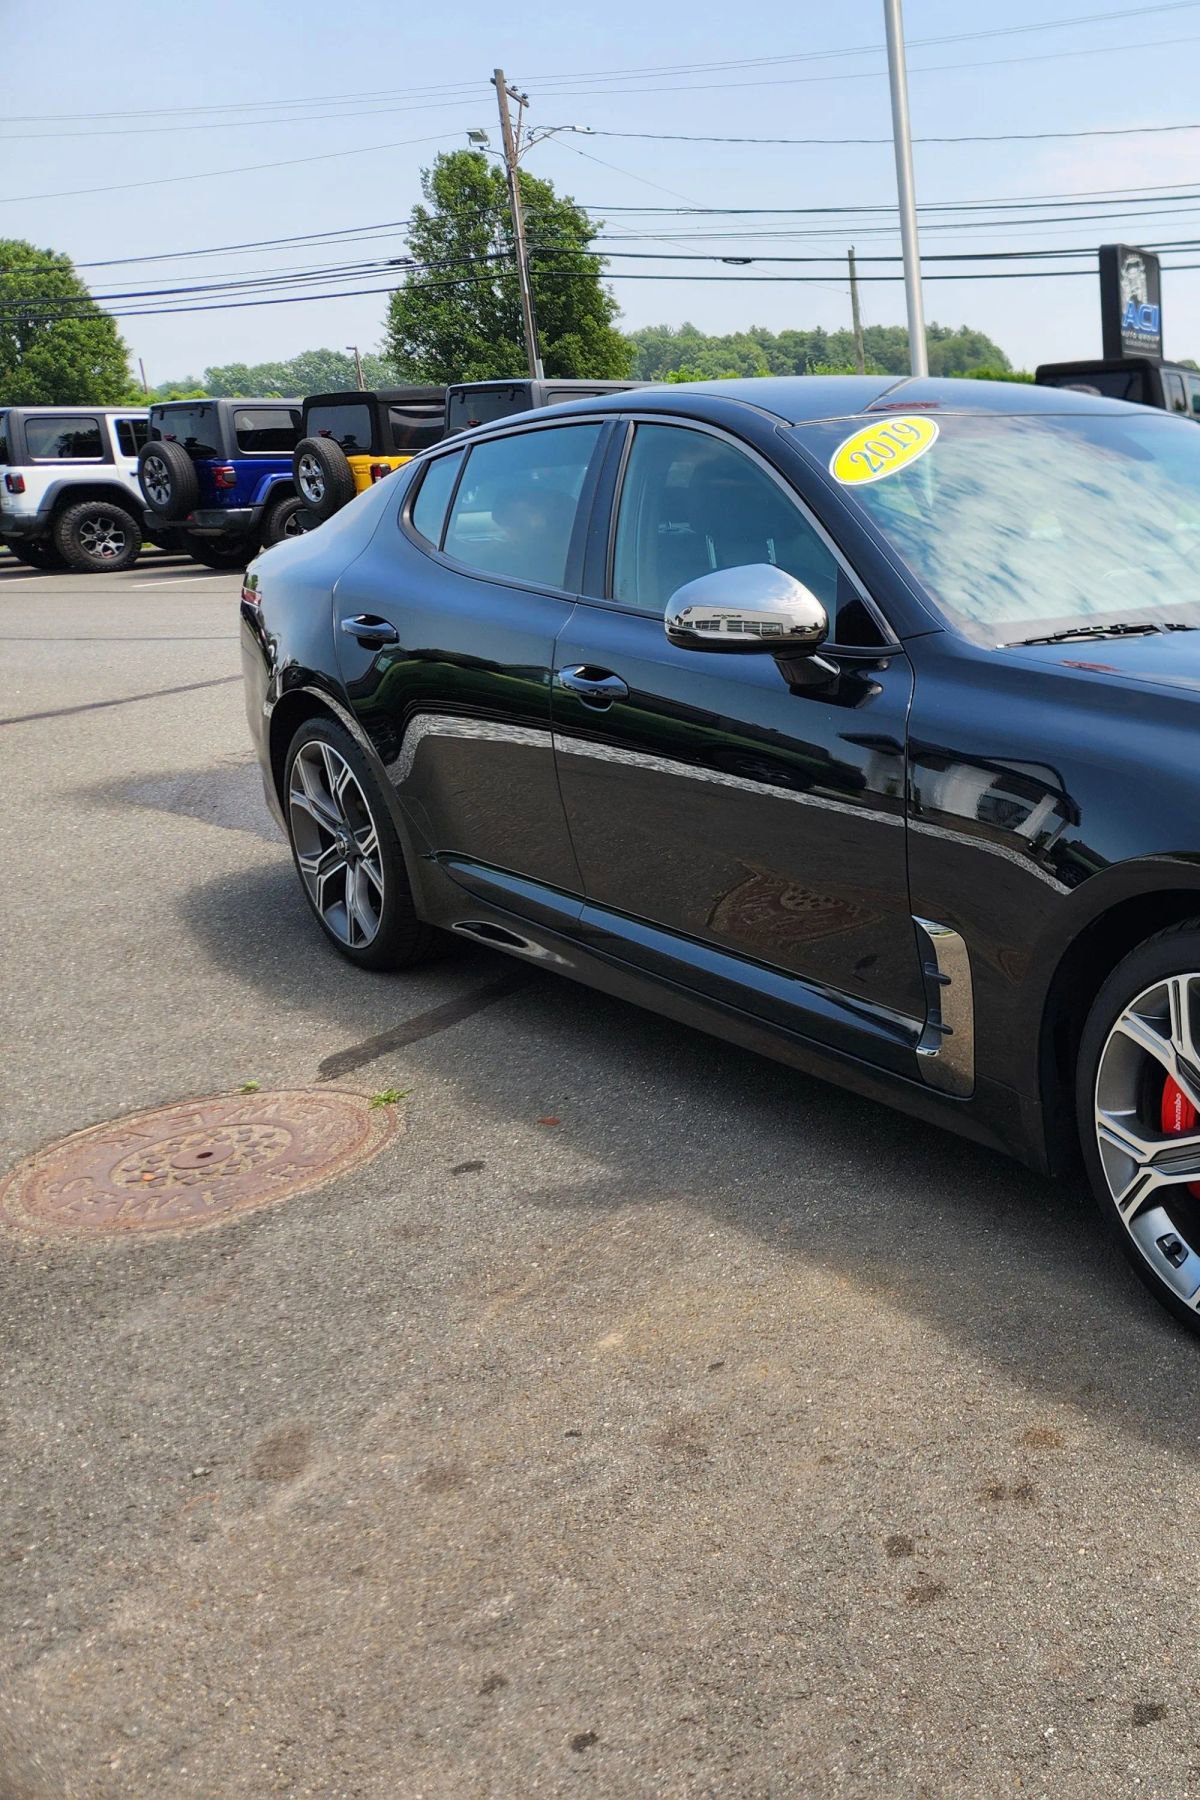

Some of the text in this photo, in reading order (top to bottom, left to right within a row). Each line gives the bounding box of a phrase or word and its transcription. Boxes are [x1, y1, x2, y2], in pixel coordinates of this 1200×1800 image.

[1122, 300, 1159, 332] ACI
[850, 423, 921, 473] 2019
[1173, 1092, 1182, 1131] brembo
